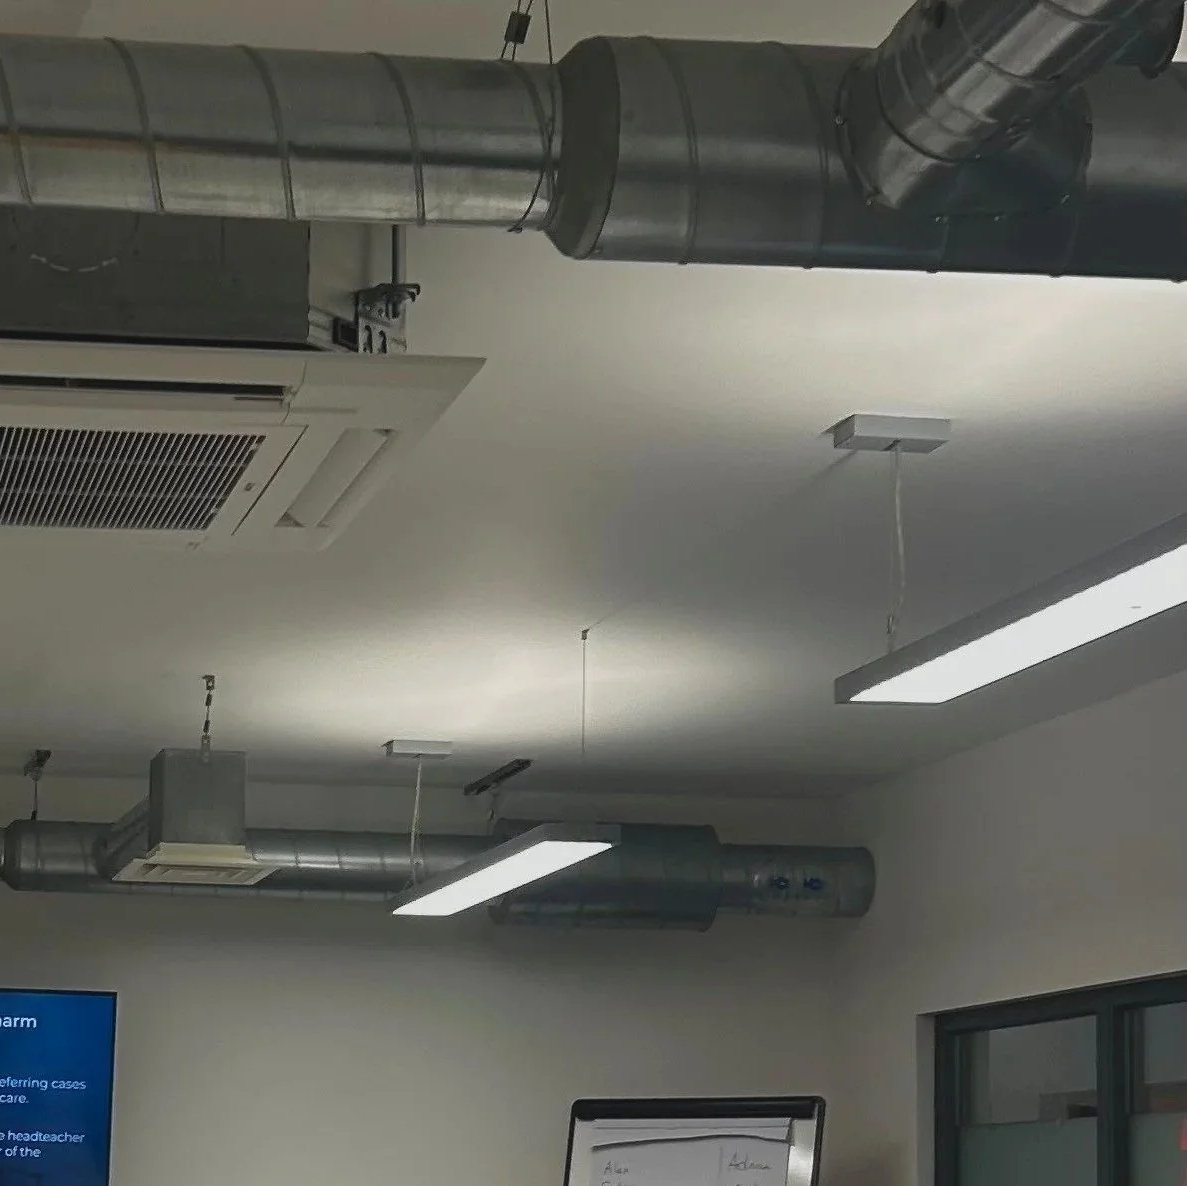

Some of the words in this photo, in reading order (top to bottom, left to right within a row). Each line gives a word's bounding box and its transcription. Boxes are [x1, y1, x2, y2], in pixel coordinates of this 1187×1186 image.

[51, 1080, 86, 1090] cases
[7, 1129, 85, 1143] headteacher
[4, 1145, 18, 1157] of
[19, 1146, 41, 1157] the
